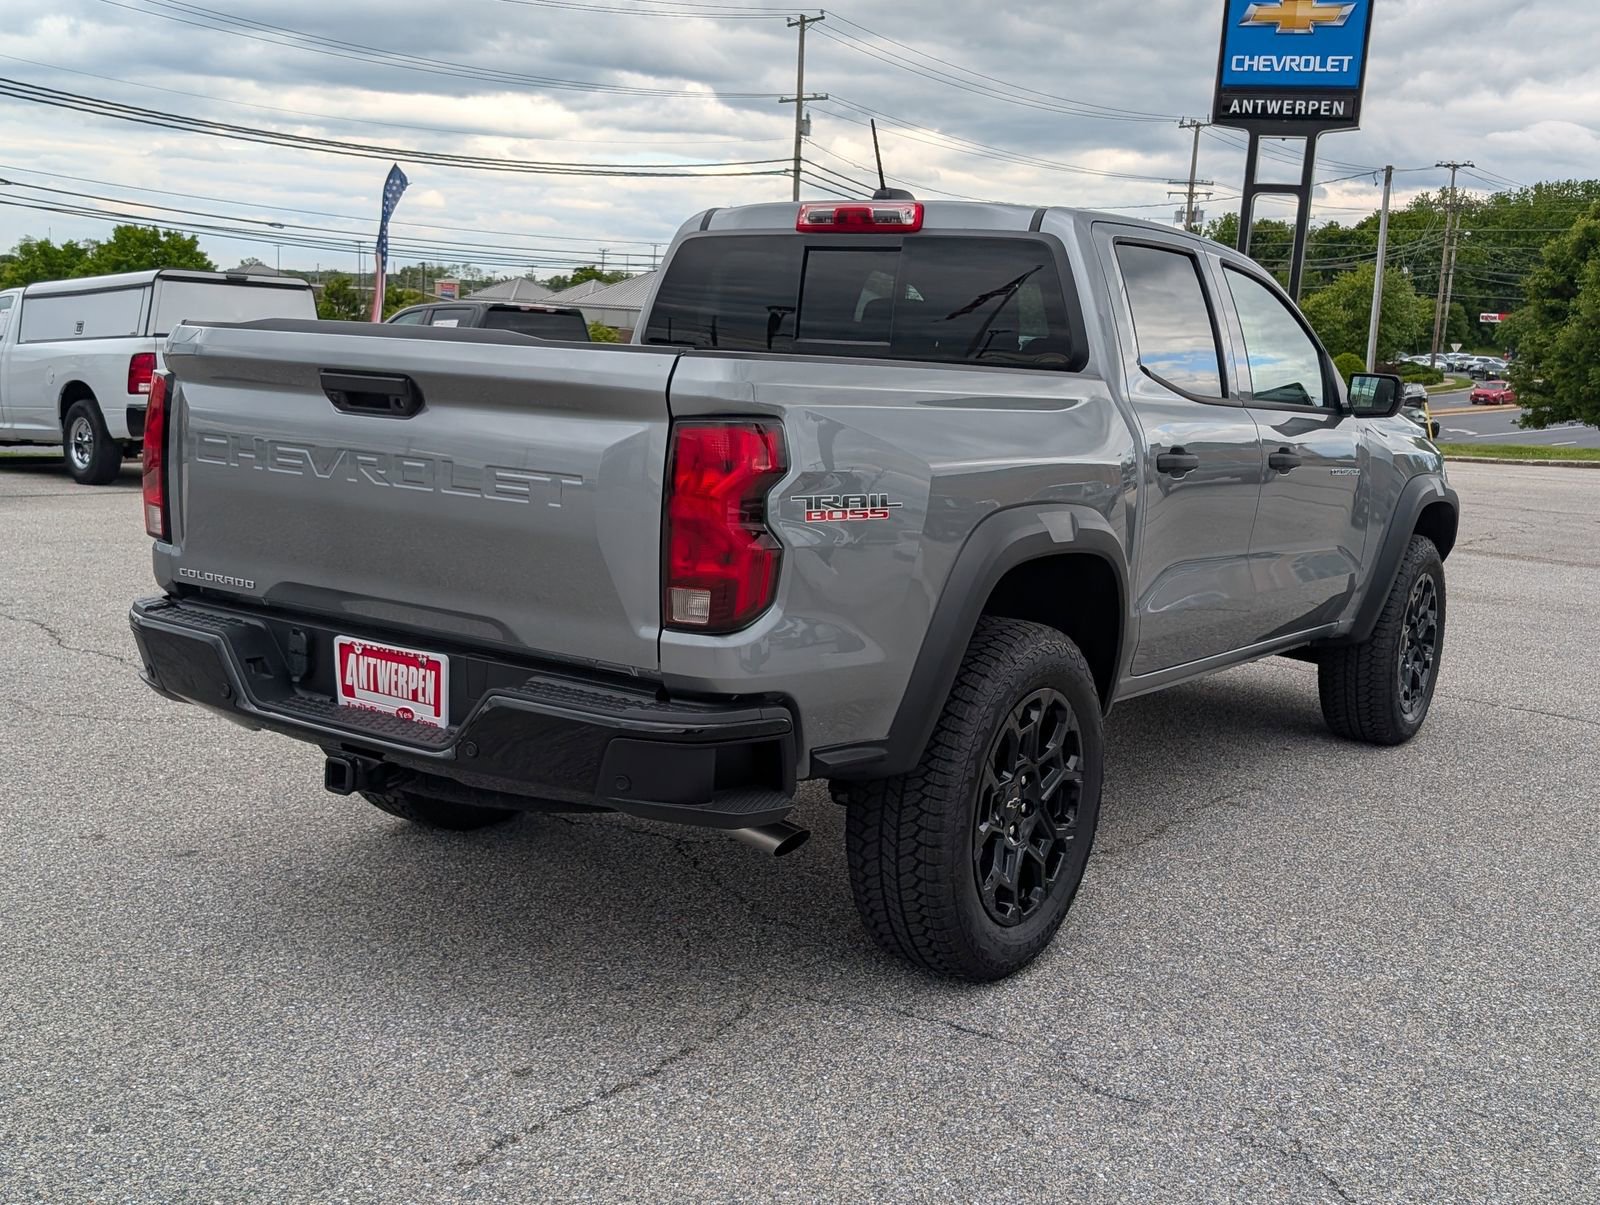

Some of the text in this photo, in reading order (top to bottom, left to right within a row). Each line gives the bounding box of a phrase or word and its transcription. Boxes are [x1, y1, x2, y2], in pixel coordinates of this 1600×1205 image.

[1231, 55, 1353, 72] CHEVROLET
[1229, 99, 1345, 115] ANTWERPEN
[197, 432, 584, 508] CHEVROLET
[791, 493, 903, 510] TRAIL
[805, 507, 889, 522] BOSS
[179, 567, 256, 589] COLORADO
[345, 652, 436, 706] ANTWERPEN
[398, 709, 412, 719] Yes
